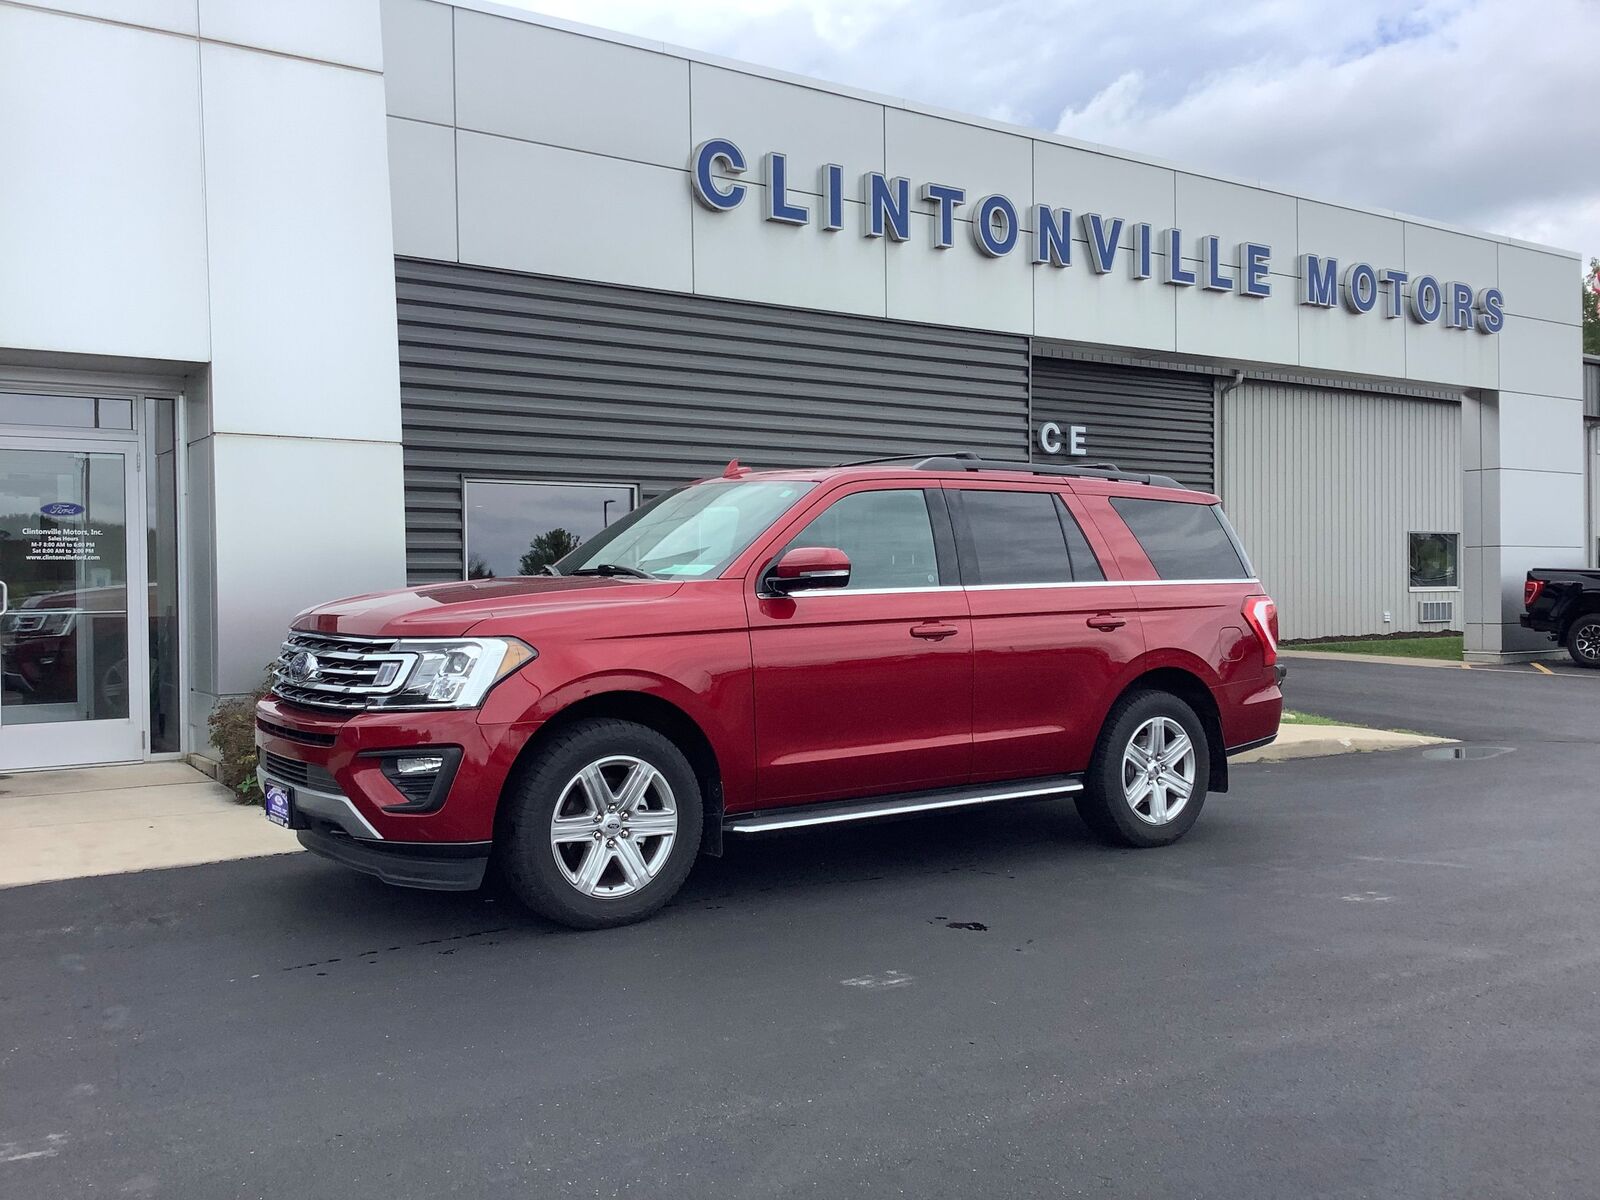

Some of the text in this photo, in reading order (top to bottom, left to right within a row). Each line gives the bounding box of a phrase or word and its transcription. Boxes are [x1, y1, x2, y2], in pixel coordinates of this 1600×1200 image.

[691, 137, 1505, 335] CLINTONVILLE MOTORS
[1038, 421, 1087, 456] CE
[22, 528, 104, 536] Clintonville Motors, Inc.
